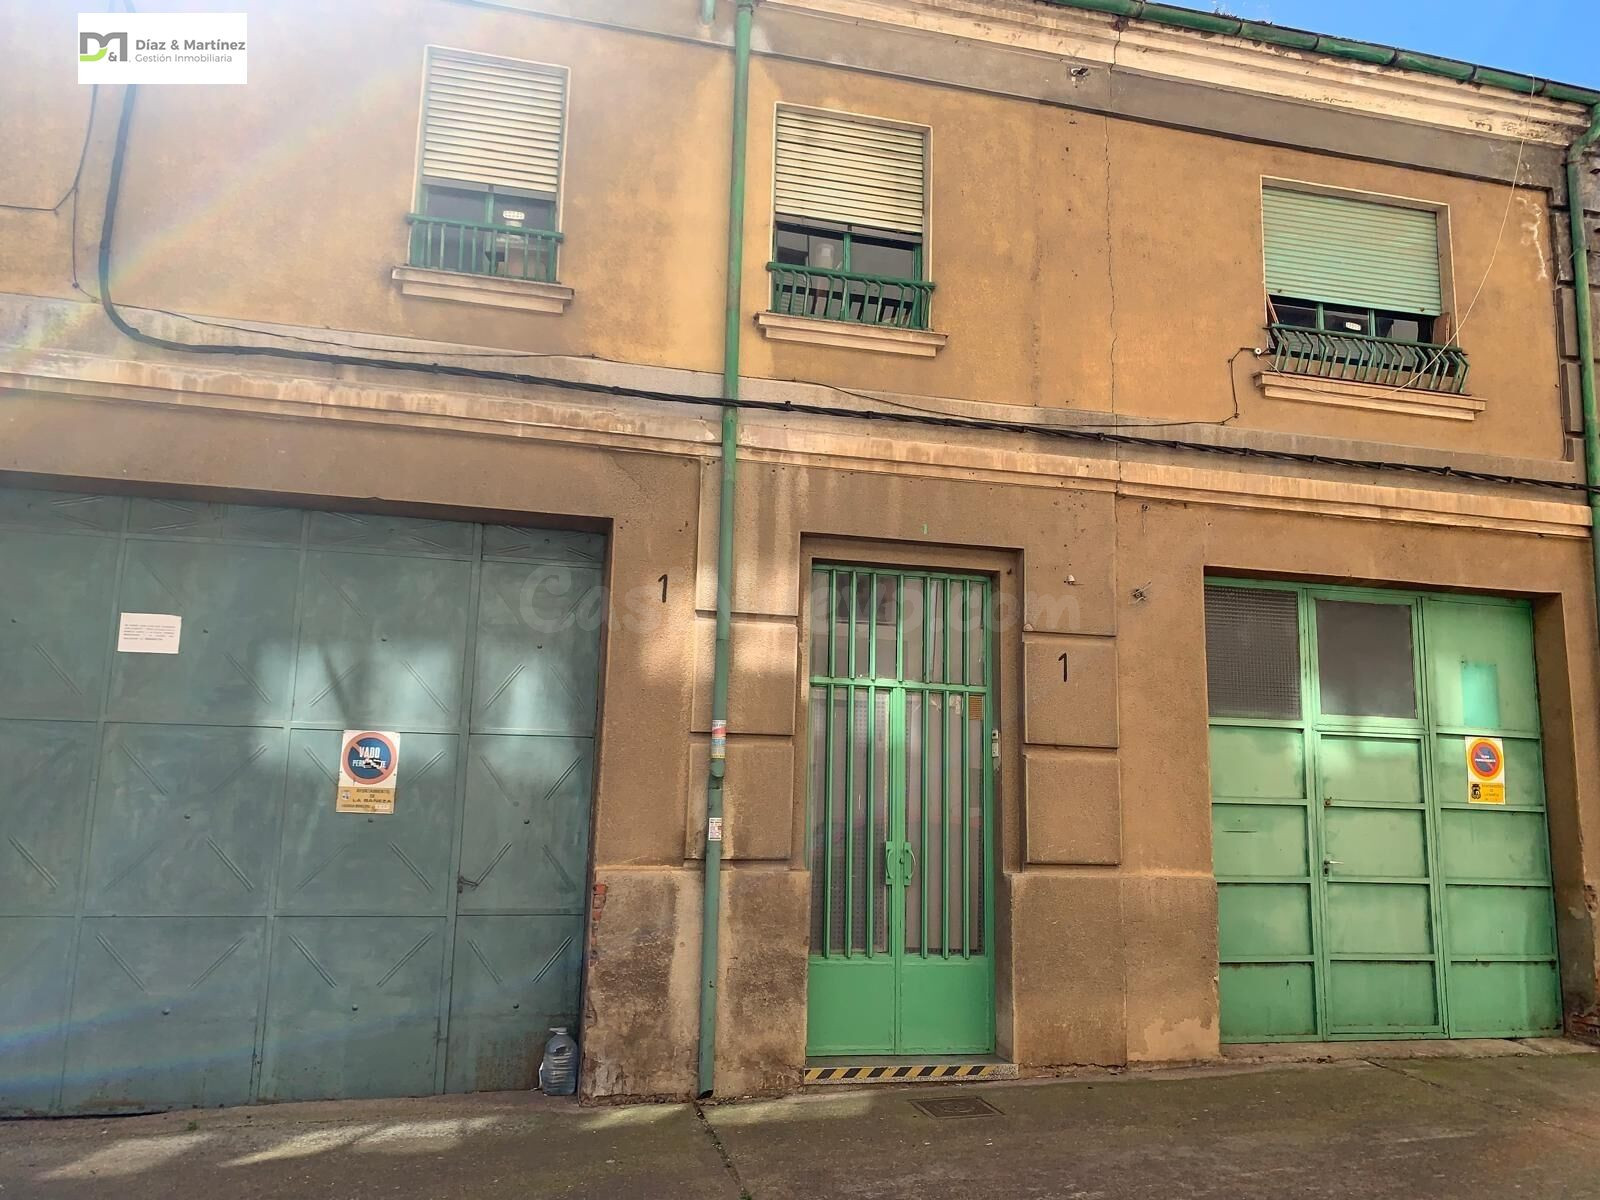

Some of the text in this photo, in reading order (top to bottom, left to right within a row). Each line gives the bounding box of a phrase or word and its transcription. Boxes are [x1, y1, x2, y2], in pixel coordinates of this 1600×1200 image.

[658, 574, 668, 603] 1
[1058, 652, 1068, 682] 1
[359, 746, 381, 758] VADO
